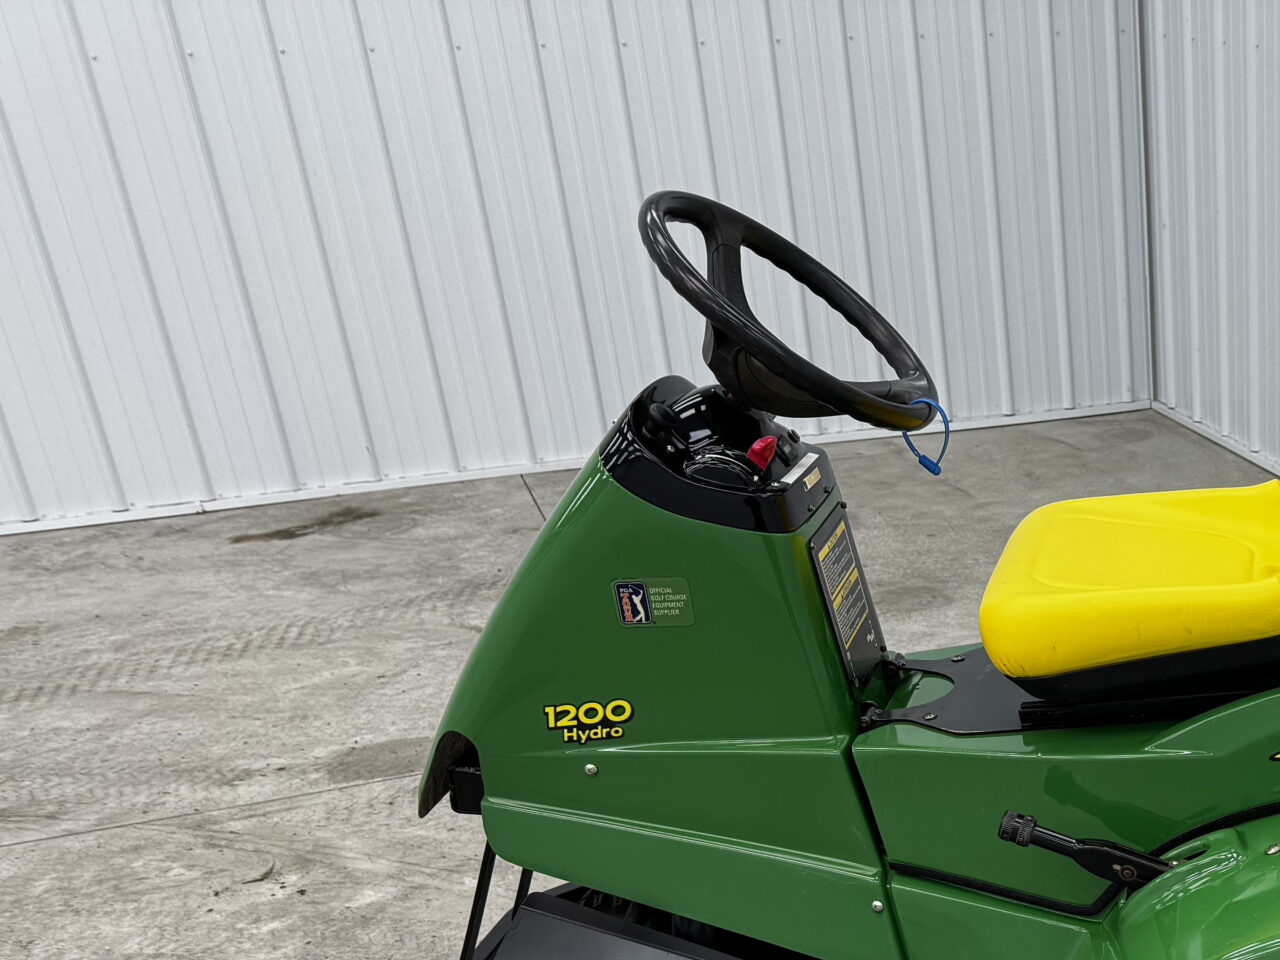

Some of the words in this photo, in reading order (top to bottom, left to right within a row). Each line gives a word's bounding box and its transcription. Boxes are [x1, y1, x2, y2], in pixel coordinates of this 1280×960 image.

[620, 593, 634, 621] TOUR
[544, 699, 633, 729] 1200
[562, 725, 624, 744] Hydro
